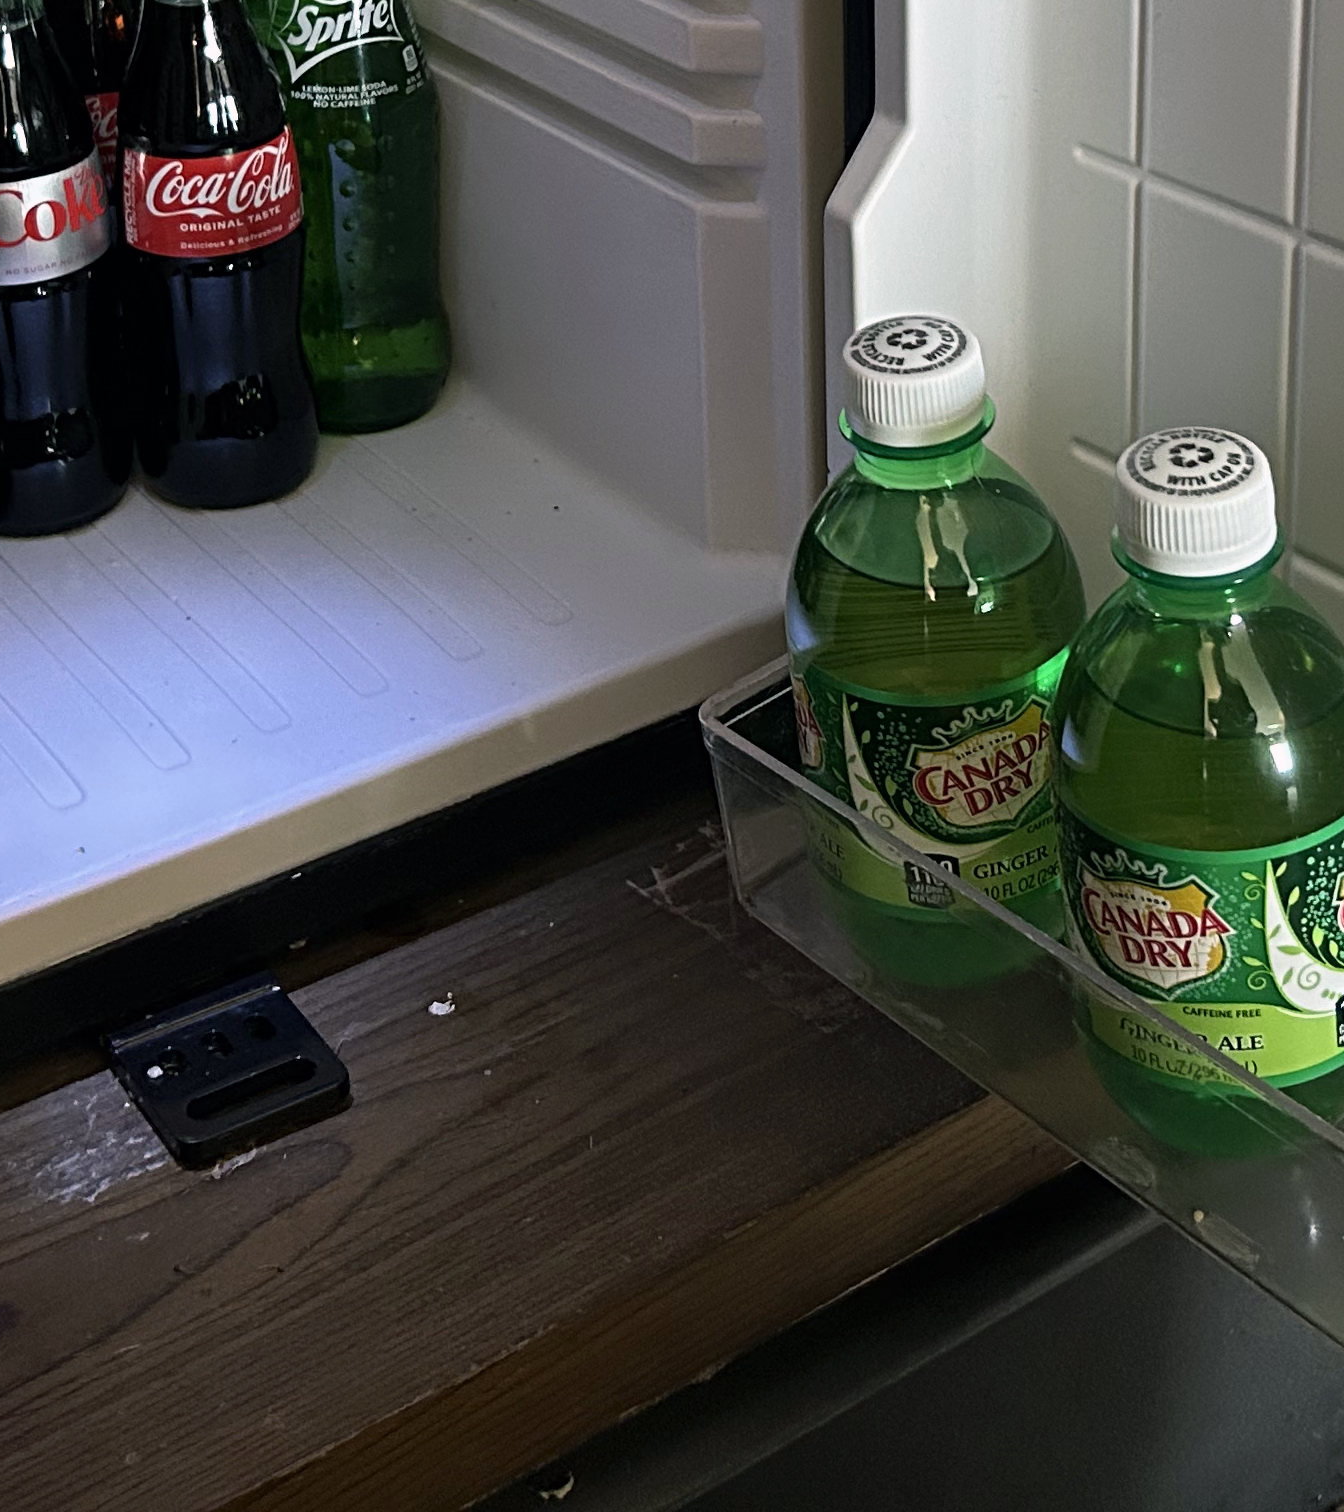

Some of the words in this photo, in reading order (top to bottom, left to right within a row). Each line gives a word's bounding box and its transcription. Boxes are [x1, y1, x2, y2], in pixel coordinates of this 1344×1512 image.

[291, 90, 314, 100] 100%
[315, 91, 359, 101] NATURAL
[361, 84, 399, 99] FLAVORS
[302, 85, 360, 93] LEMON-LIME
[362, 80, 387, 92] SODA
[313, 100, 329, 108] NO
[330, 97, 376, 108] CAFFEINE
[146, 124, 294, 219] Coca-Cola
[179, 219, 244, 232] ORIGINAL
[248, 205, 281, 223] TASTE
[180, 241, 225, 250] Delicious
[238, 224, 283, 245] Refreshing
[23, 262, 58, 275] SUGAR
[1167, 474, 1207, 487] WITH
[1210, 464, 1235, 483] CAP
[913, 722, 1052, 806] CANADA
[956, 744, 985, 761] SINCE
[963, 761, 1035, 816] DRY
[973, 844, 1049, 879] GINGER
[1002, 882, 1016, 898] FL
[1017, 874, 1036, 893] OZ
[1110, 891, 1136, 901] SINCE
[1083, 888, 1231, 938] CANADA
[1119, 935, 1193, 967] DRY
[1183, 1006, 1233, 1018] CAFFEINE
[1236, 1008, 1262, 1018] FREE
[1218, 1035, 1265, 1051] ALE
[1131, 1045, 1146, 1063] 10
[1150, 1051, 1161, 1066] FL
